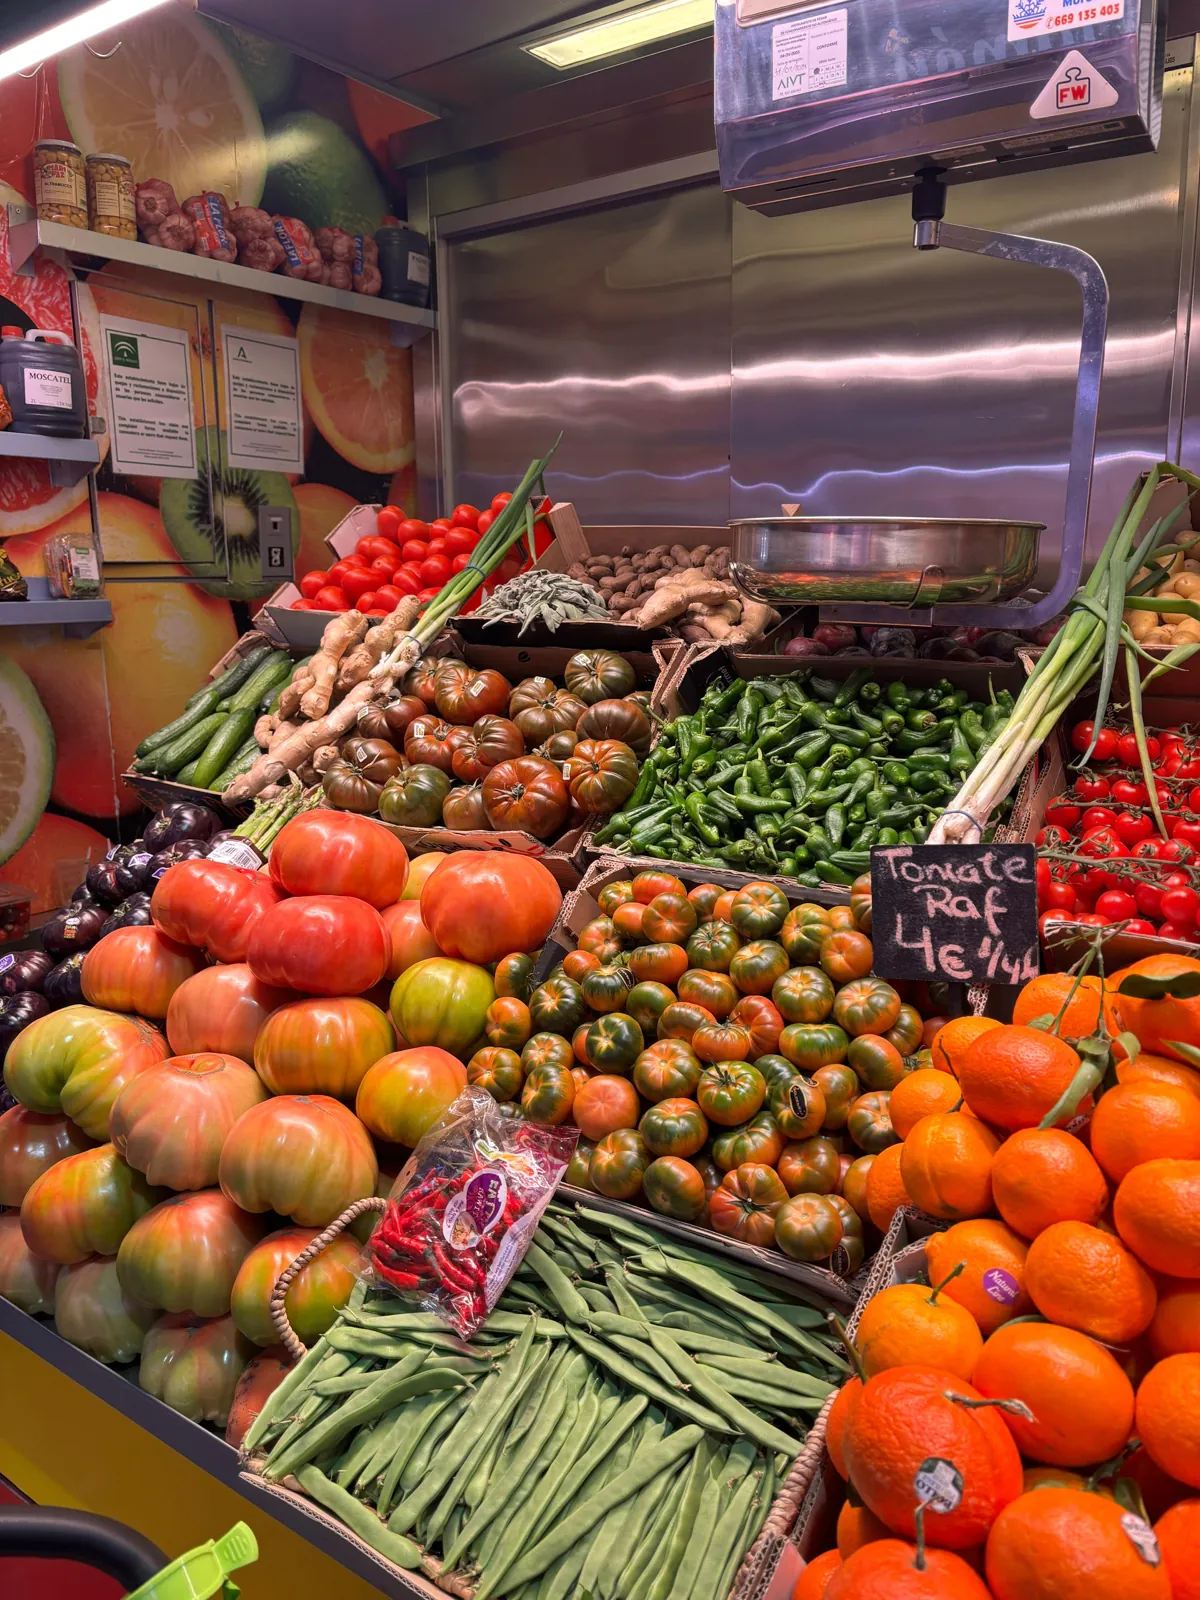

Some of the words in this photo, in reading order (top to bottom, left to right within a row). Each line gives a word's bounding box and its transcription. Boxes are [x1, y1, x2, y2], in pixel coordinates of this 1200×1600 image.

[1054, 13, 1074, 26] 669
[1078, 8, 1096, 21] 135
[1100, 3, 1120, 16] 403
[1059, 84, 1087, 103] FW
[209, 202, 220, 215] LA
[29, 372, 71, 384] MOSCATEL
[874, 846, 1034, 884] Tomate
[912, 884, 1008, 937] Raf
[895, 912, 973, 980] 4€
[988, 1270, 1020, 1298] Natural
